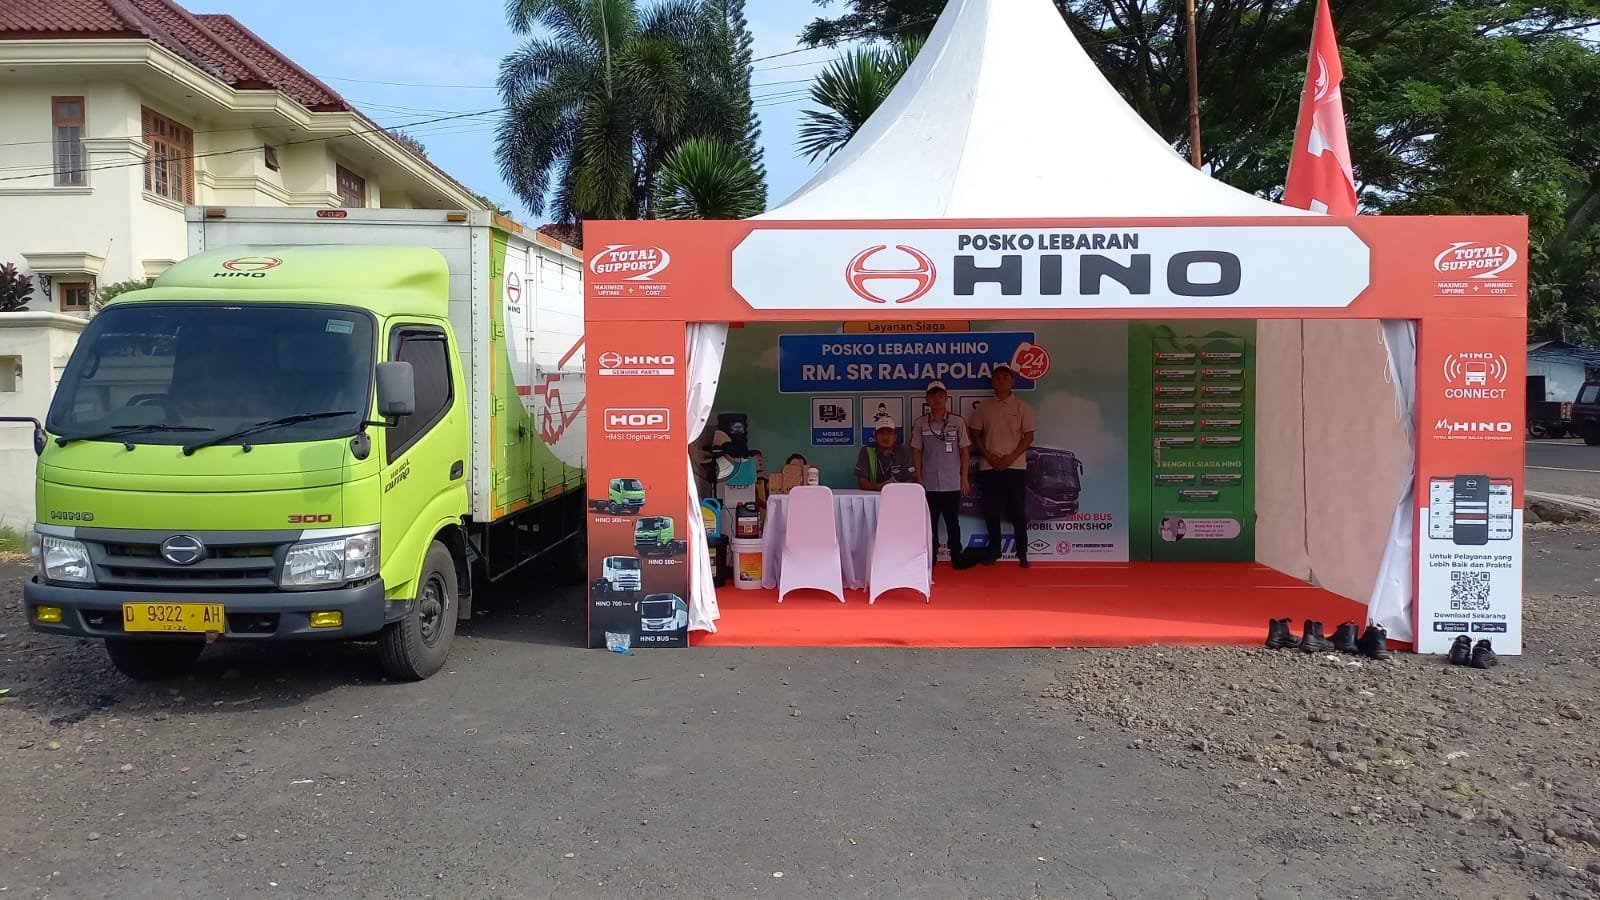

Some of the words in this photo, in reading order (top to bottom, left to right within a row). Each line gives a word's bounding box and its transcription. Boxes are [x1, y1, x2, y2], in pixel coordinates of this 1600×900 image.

[957, 234, 1034, 251] POSKO
[1038, 233, 1139, 250] LEBARAN
[610, 249, 657, 262] TOTAL
[1455, 246, 1504, 260] TOTAL
[597, 260, 657, 273] SUPPORT
[1441, 257, 1503, 271] SUPPORT
[953, 250, 1242, 297] HINO
[508, 306, 521, 314] HINO
[867, 322, 913, 333] Layanan
[916, 321, 945, 332] Siaga
[822, 343, 875, 356] POSKO
[878, 342, 945, 355] LEBARAN
[950, 342, 989, 354] HINO
[624, 355, 675, 365] HINO
[1021, 352, 1044, 369] 24
[802, 364, 842, 380] RM.
[846, 363, 873, 380] SR
[1445, 388, 1507, 398] CONNECT
[610, 414, 664, 426] HOP
[626, 433, 652, 441] Original
[51, 511, 94, 521] HINO
[288, 514, 332, 523] 300
[1094, 513, 1112, 521] BUS
[1055, 522, 1113, 531] WORKSHOP
[1454, 553, 1493, 561] Pelayanan
[125, 606, 135, 622] D
[147, 605, 183, 622] 9322
[203, 606, 220, 623] AH
[1472, 612, 1507, 620] Sekarang
